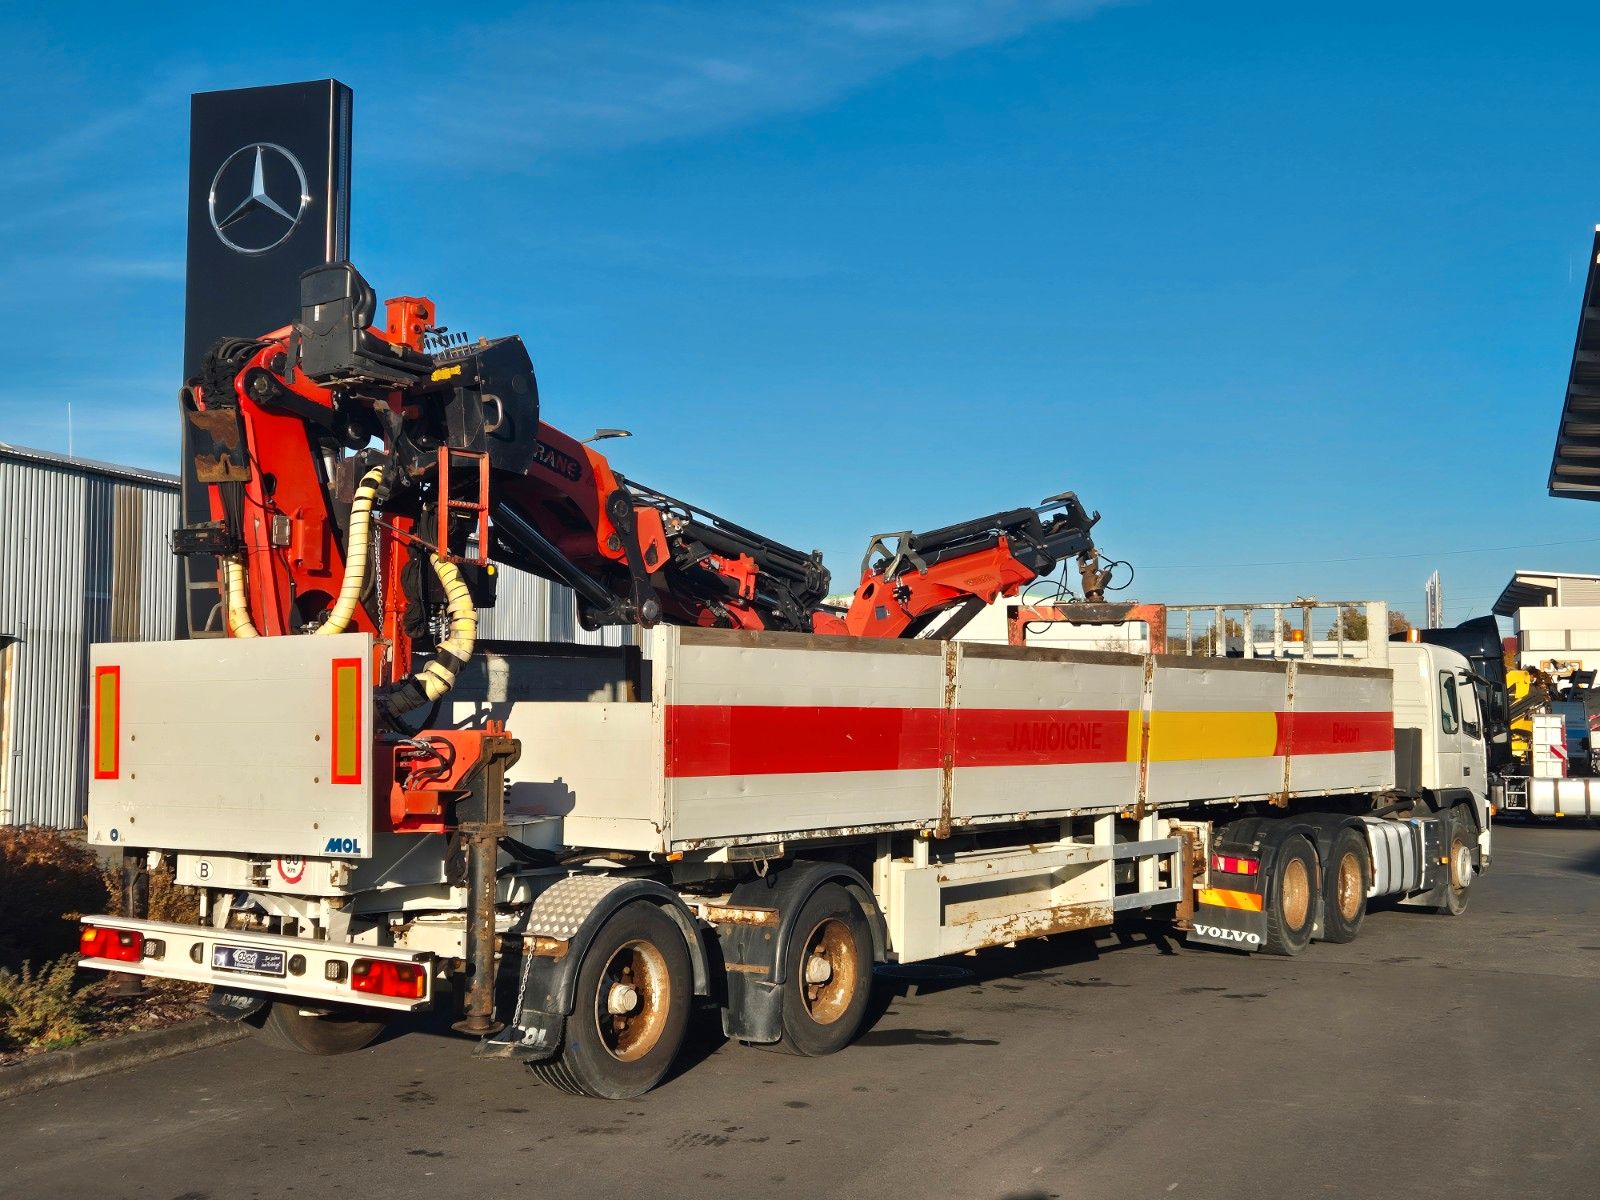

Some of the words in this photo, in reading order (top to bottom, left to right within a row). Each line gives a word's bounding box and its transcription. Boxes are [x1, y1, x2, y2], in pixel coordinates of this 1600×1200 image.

[1006, 722, 1103, 751] JAMOIGNE
[324, 837, 361, 853] MOL
[200, 862, 209, 878] B
[1192, 923, 1261, 944] VOLVO
